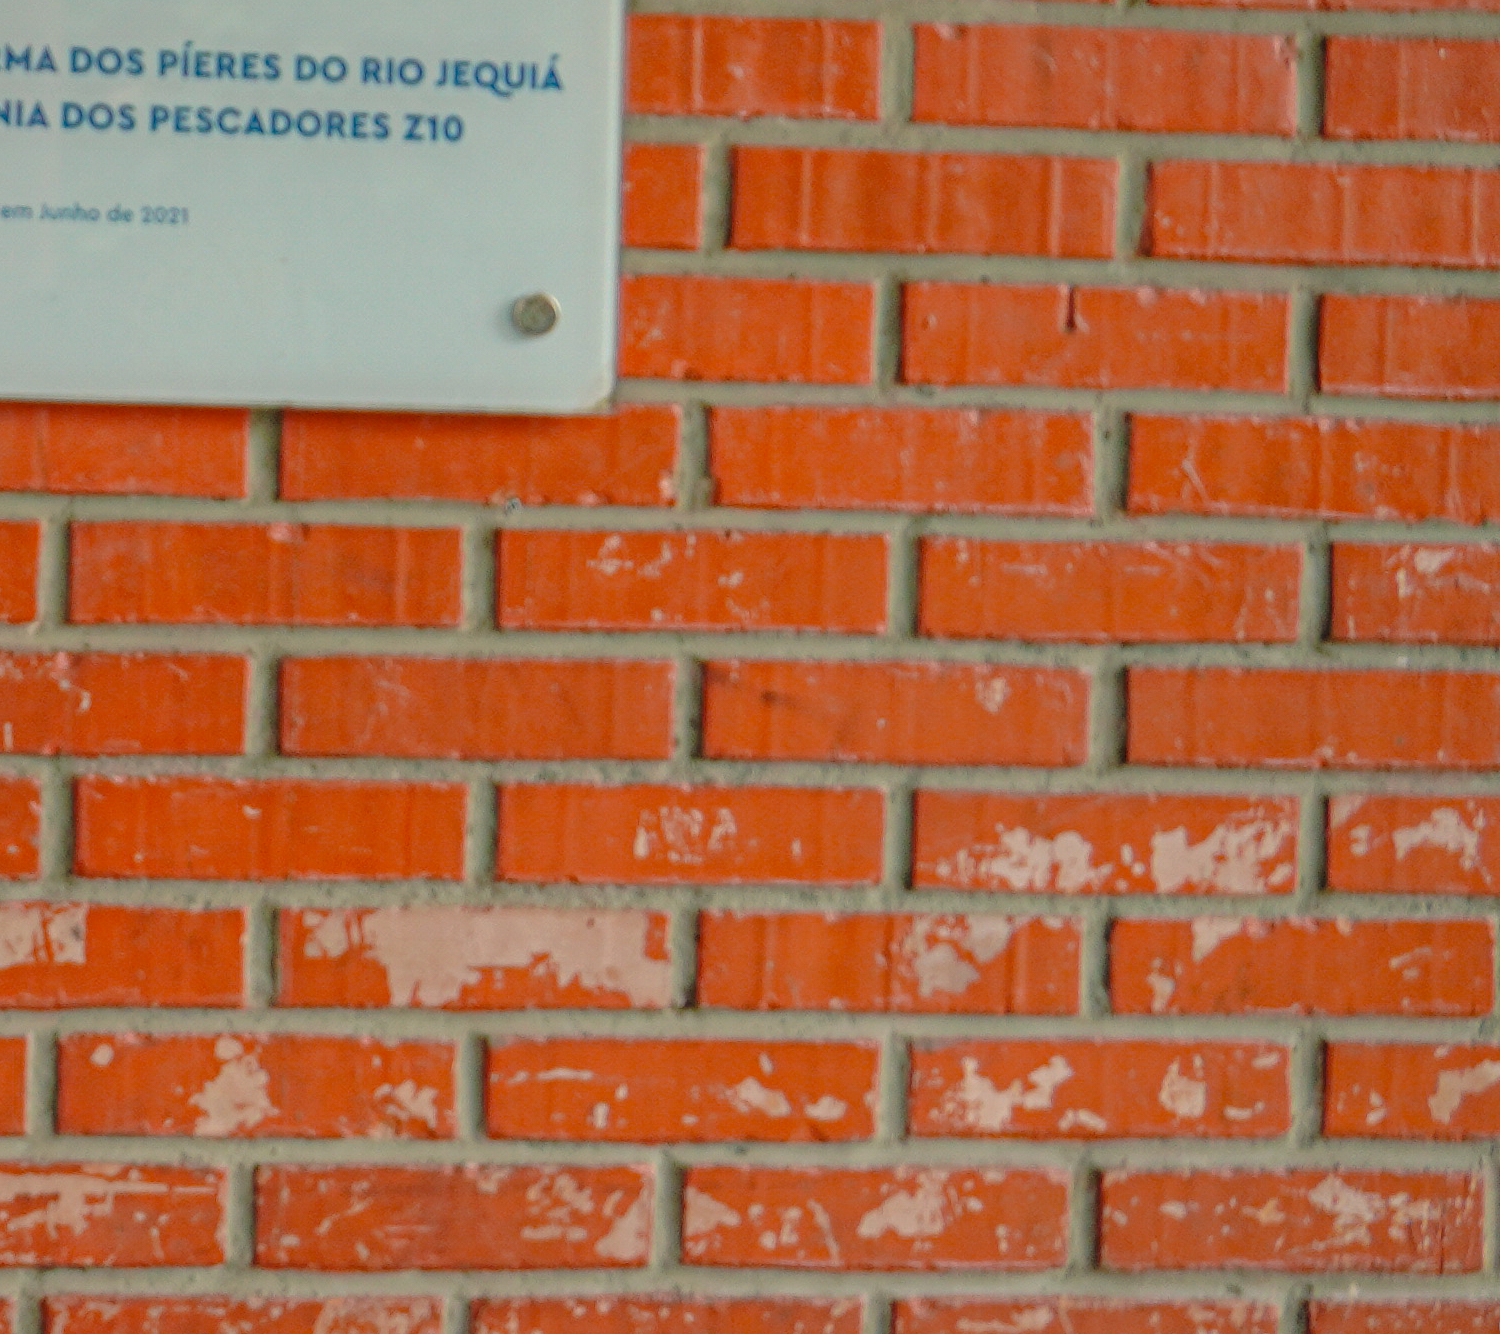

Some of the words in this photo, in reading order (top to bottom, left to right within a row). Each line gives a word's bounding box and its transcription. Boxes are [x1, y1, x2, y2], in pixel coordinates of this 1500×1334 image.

[69, 44, 146, 77] DOS
[157, 39, 282, 83] PÍERES
[294, 53, 349, 86] DO
[360, 56, 426, 88] RIO
[435, 53, 564, 100] JEQUIÁ
[60, 100, 137, 133] DOS
[148, 103, 392, 142] PESCADORES
[402, 112, 465, 145] Z10
[38, 201, 101, 224] Junho
[105, 202, 135, 225] de
[140, 204, 190, 228] 2021
